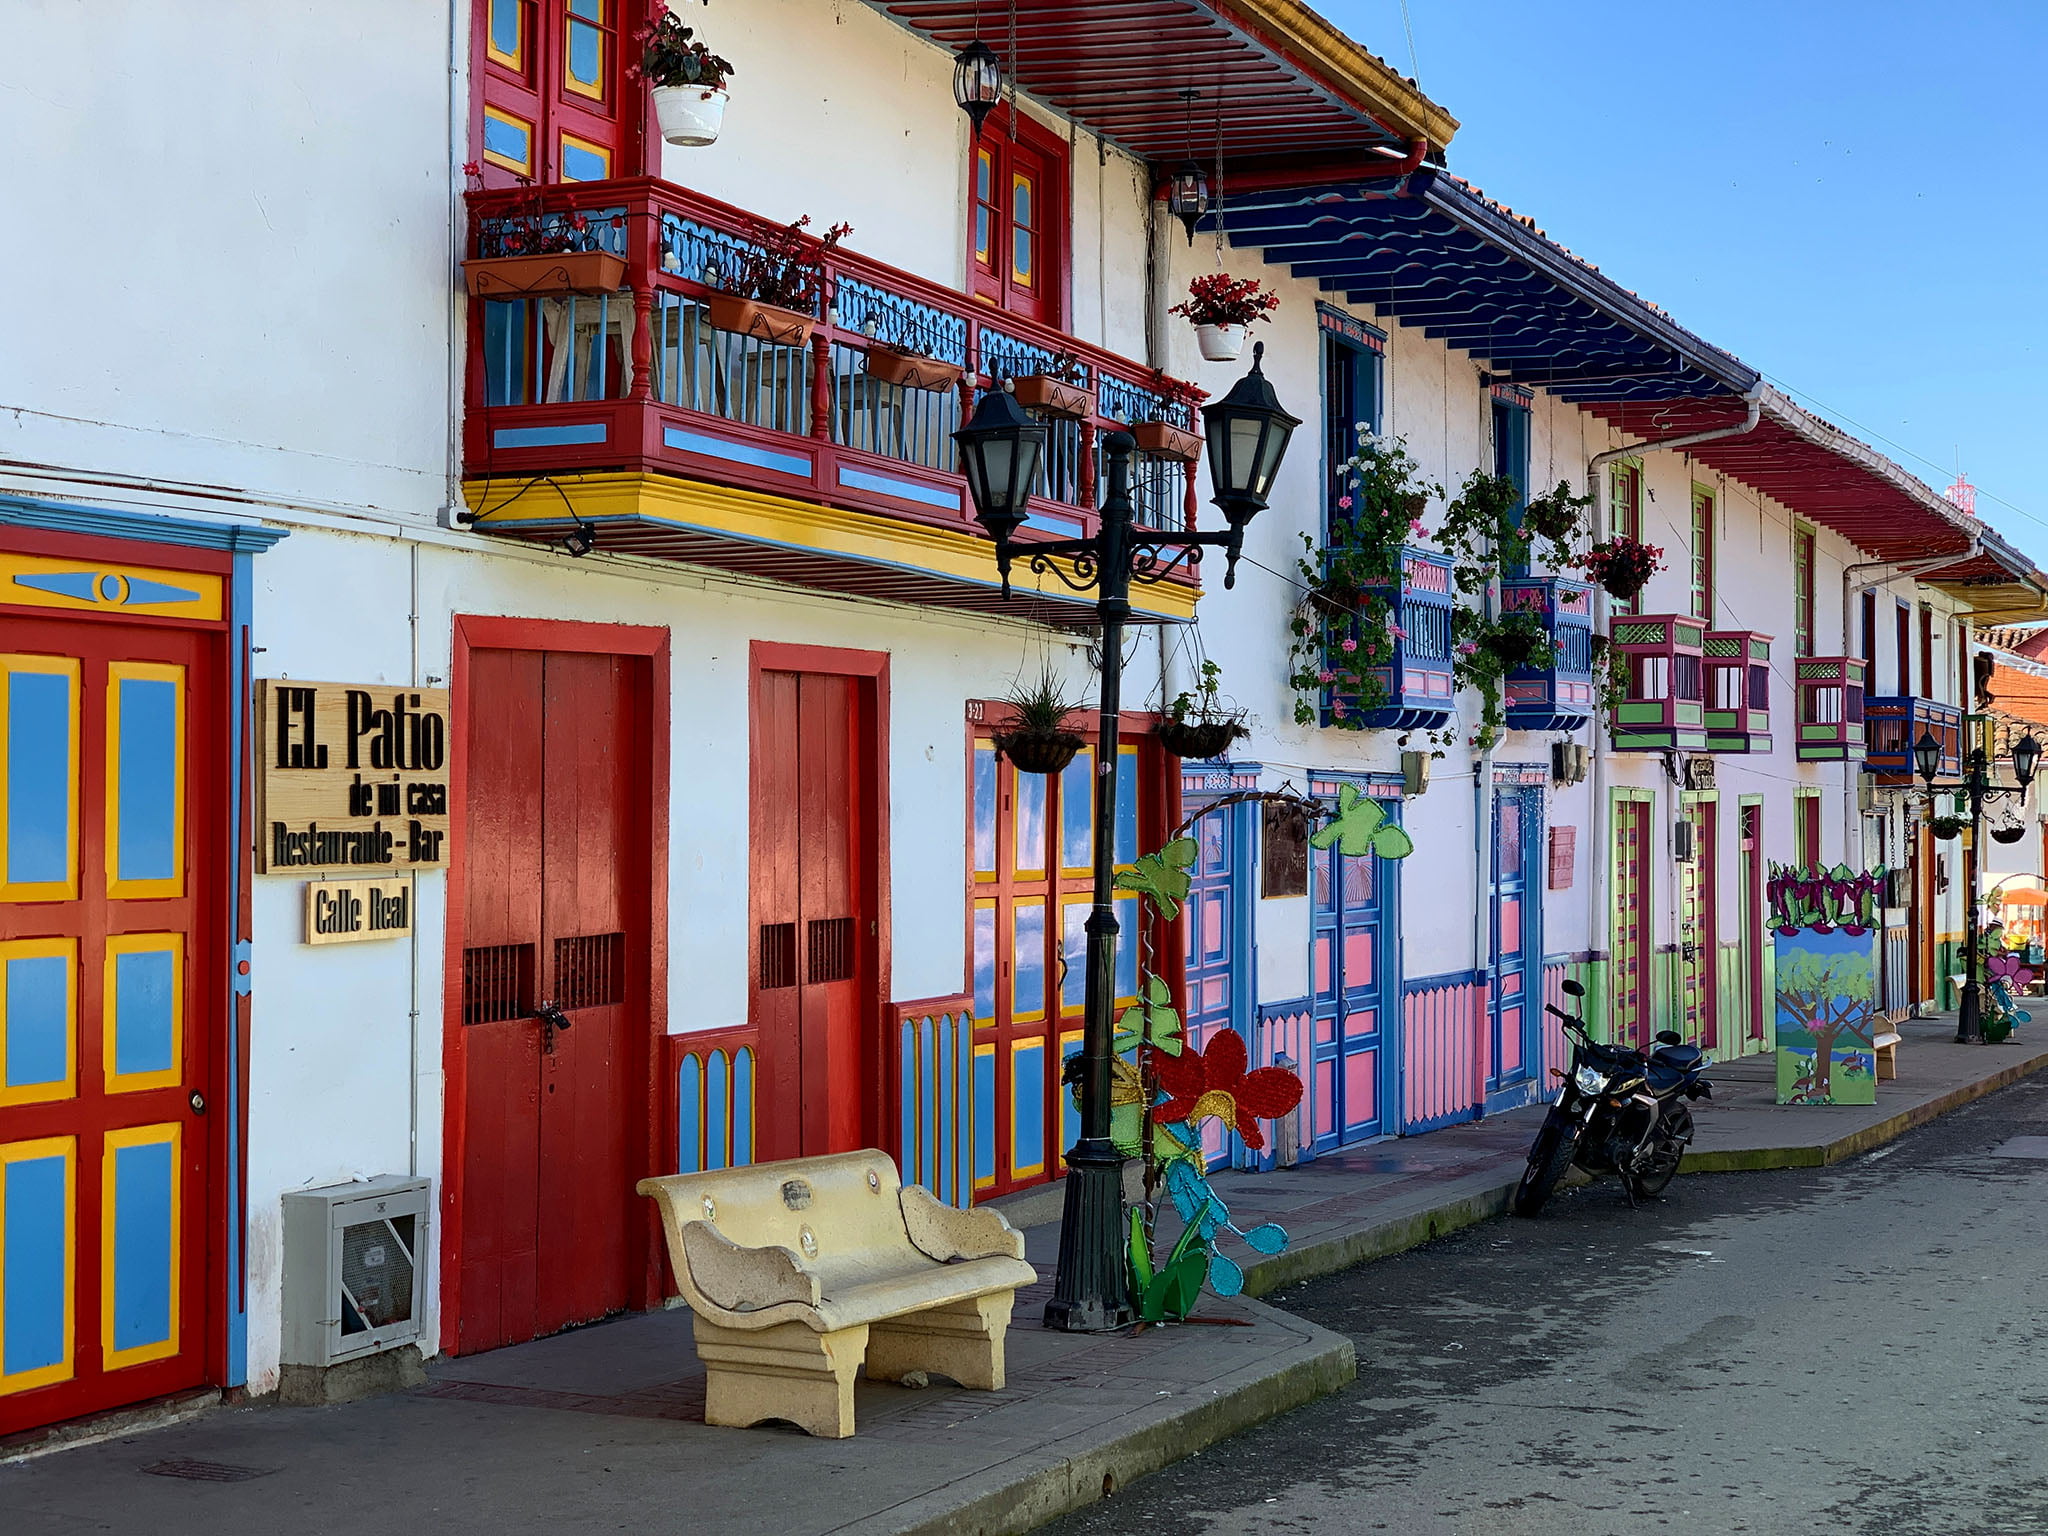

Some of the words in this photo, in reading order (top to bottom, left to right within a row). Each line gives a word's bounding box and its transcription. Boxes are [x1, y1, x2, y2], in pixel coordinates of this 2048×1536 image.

[345, 690, 444, 770] Patio
[349, 773, 373, 816] de
[378, 773, 401, 816] mi
[407, 782, 447, 815] casa
[408, 820, 444, 863] Bar
[316, 888, 363, 934] Calle
[369, 886, 409, 931] Real
